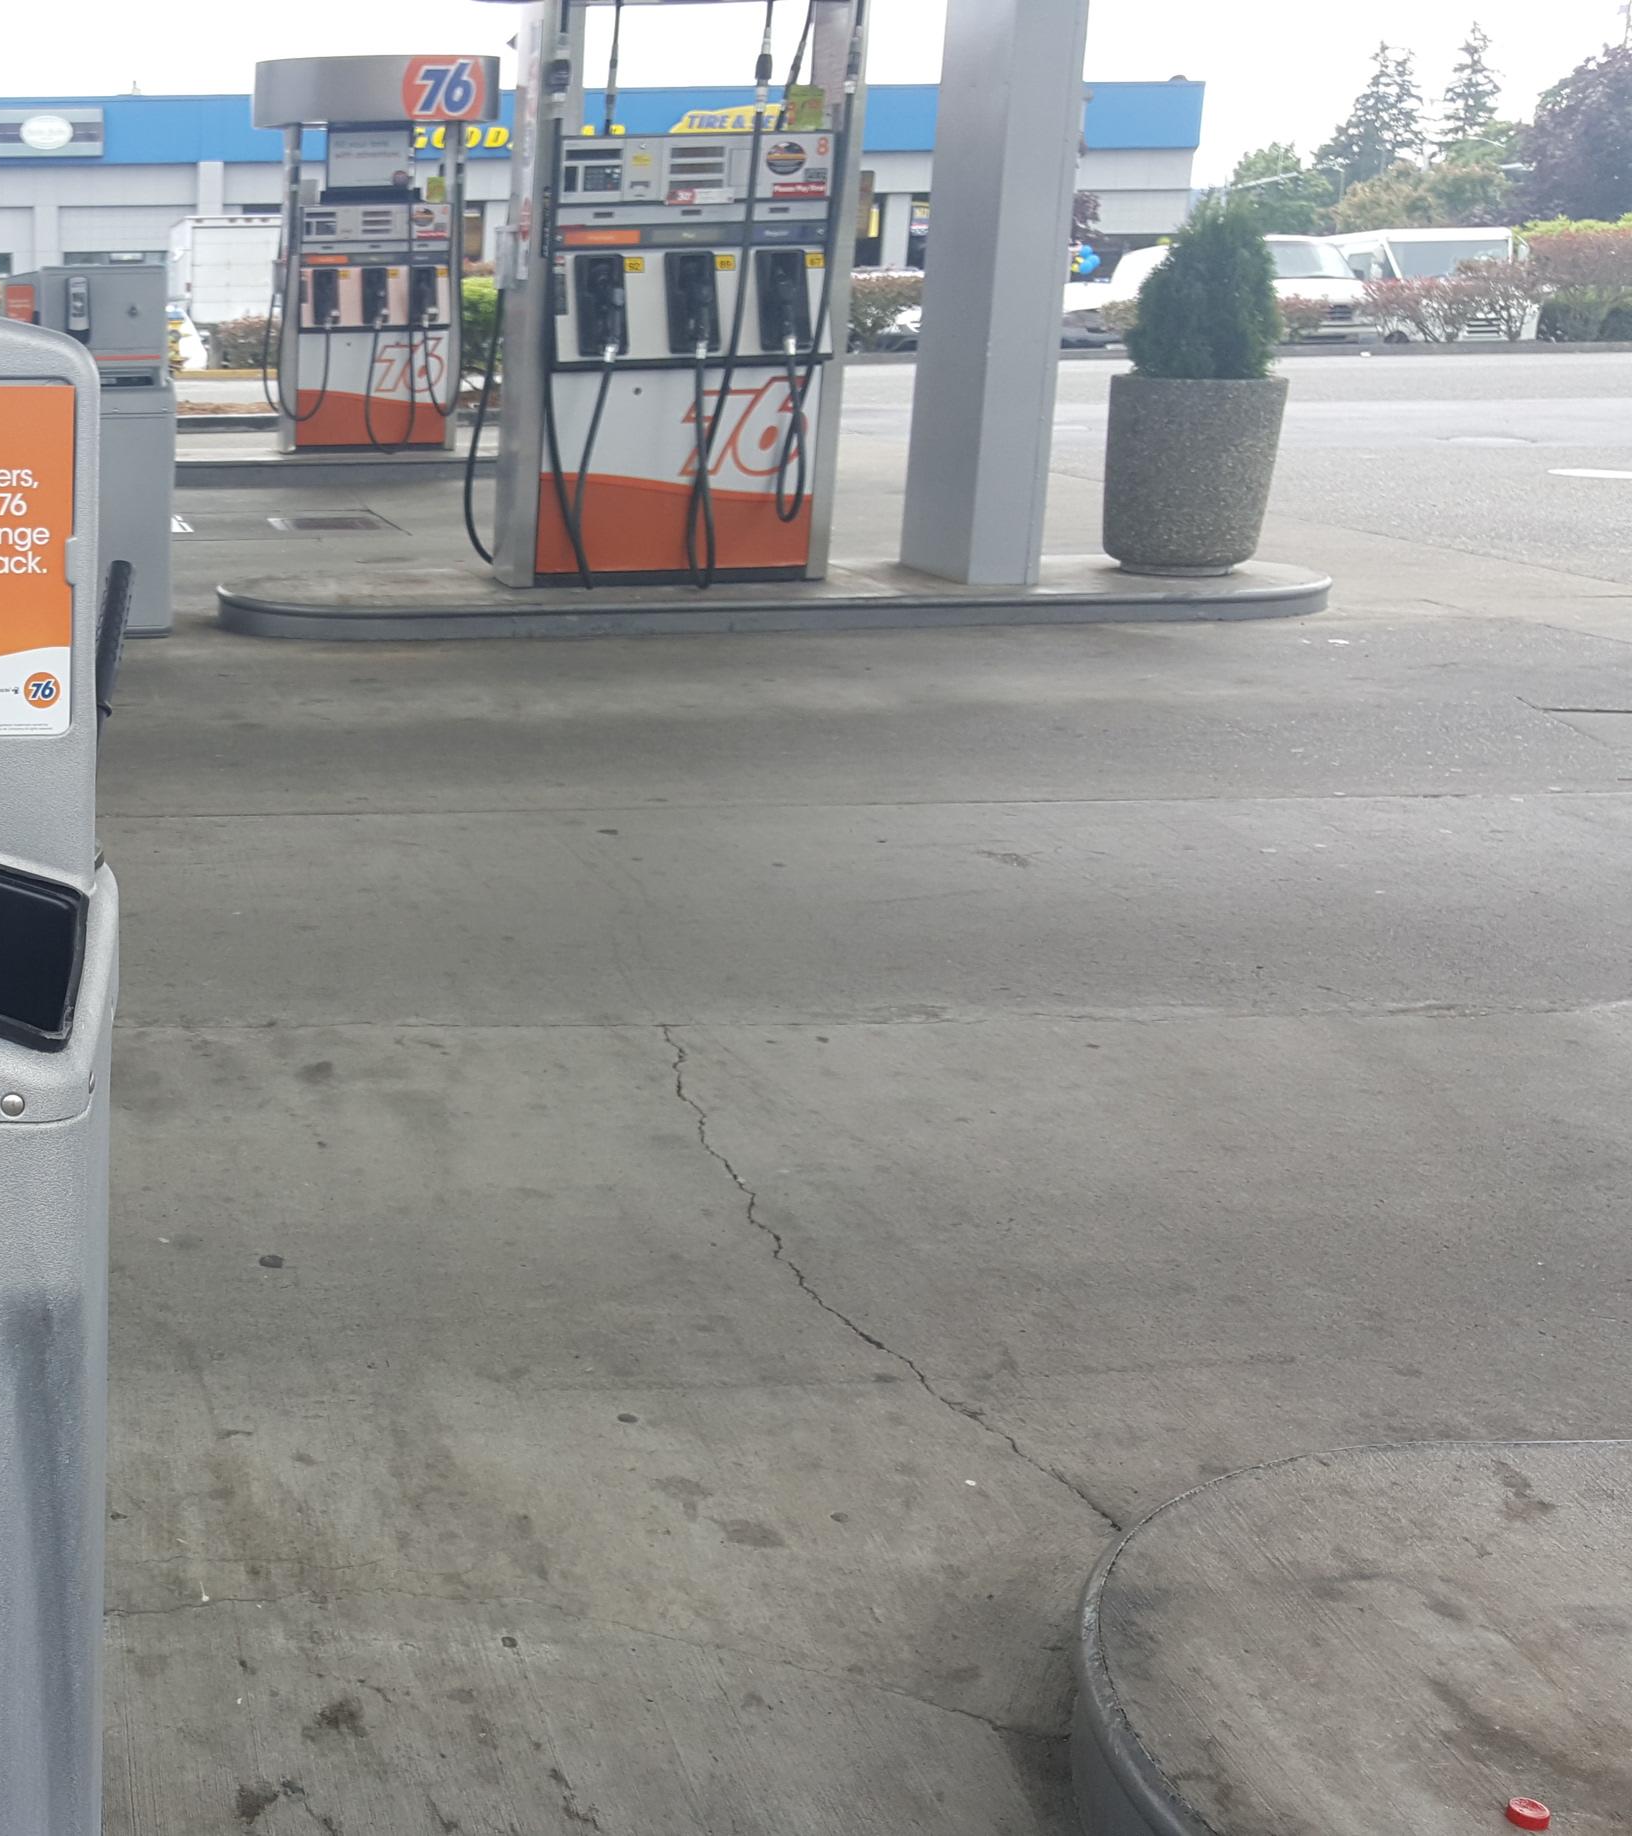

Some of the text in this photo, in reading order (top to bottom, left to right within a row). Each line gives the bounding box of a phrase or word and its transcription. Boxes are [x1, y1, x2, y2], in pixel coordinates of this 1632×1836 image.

[414, 60, 476, 115] 76
[688, 114, 727, 130] TIRE
[816, 137, 829, 156] 8
[679, 376, 808, 477] 76
[29, 679, 55, 700] 76
